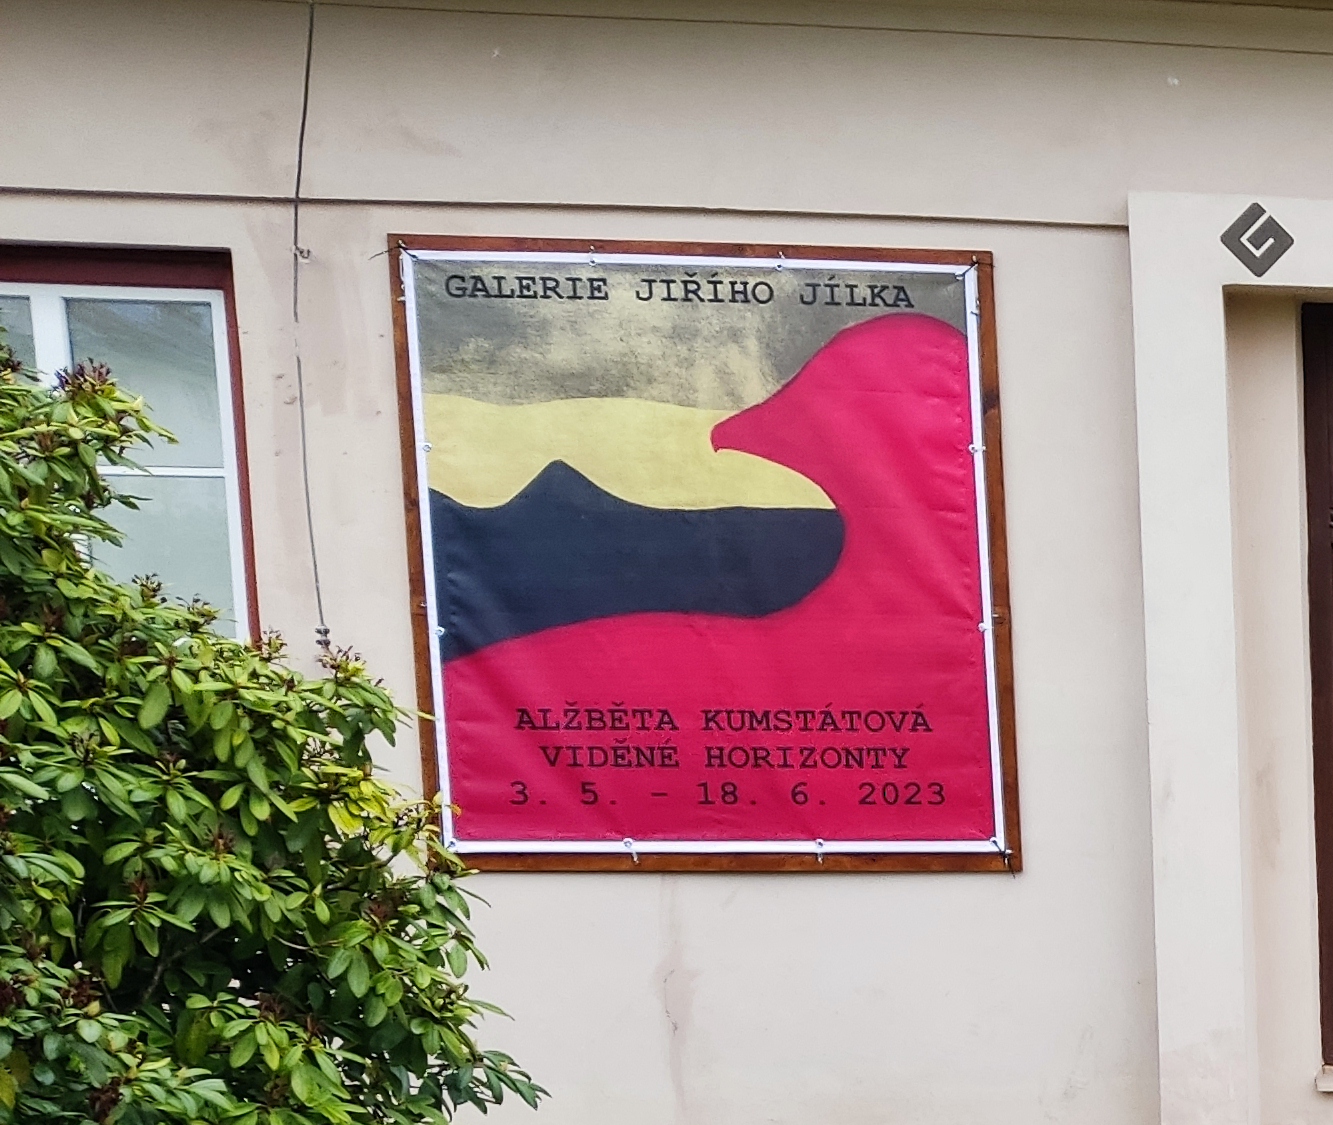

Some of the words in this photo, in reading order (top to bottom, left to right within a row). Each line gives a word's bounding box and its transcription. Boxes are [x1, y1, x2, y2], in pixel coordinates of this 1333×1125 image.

[445, 274, 609, 301] GALERIE
[636, 270, 774, 305] JIŘÍHO
[800, 275, 915, 309] JÍLKA
[514, 702, 679, 732] ALŽBĚTA
[702, 702, 933, 733] KUMSTÁTOVÁ
[539, 739, 679, 768] VIDĚNÉ
[705, 746, 910, 769] HORIZONTY
[510, 781, 547, 806] 3.
[580, 781, 617, 806] 5.
[697, 781, 757, 806] 18.
[790, 781, 826, 806] 6.
[859, 781, 946, 806] 2023
